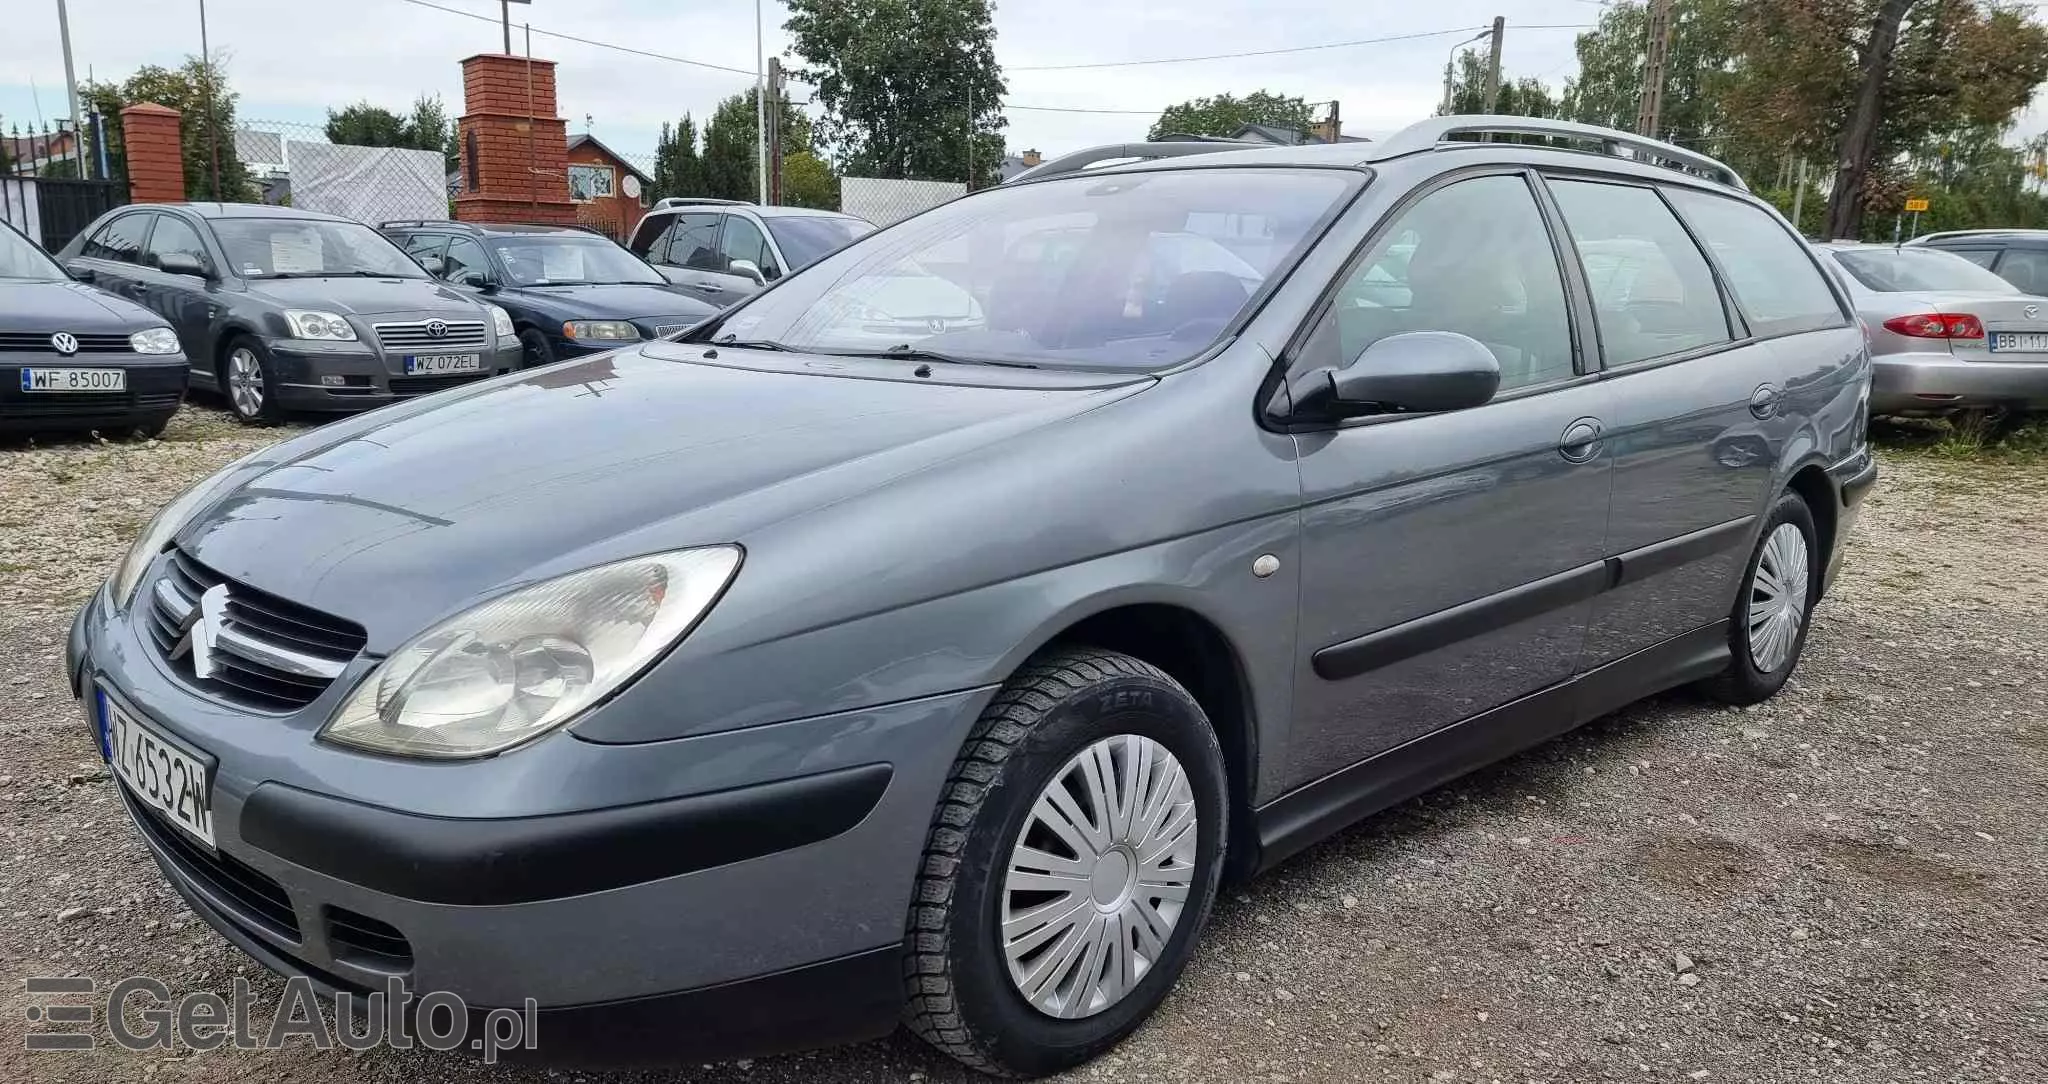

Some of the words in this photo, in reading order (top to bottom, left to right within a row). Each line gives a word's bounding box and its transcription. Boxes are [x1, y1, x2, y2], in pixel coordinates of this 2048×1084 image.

[416, 357, 433, 370] WZ
[438, 355, 477, 369] 072EL
[33, 371, 61, 388] WF
[69, 371, 121, 388] 85007
[1101, 690, 1153, 712] ZETA
[106, 703, 131, 778] WZ
[136, 732, 208, 835] 6532W
